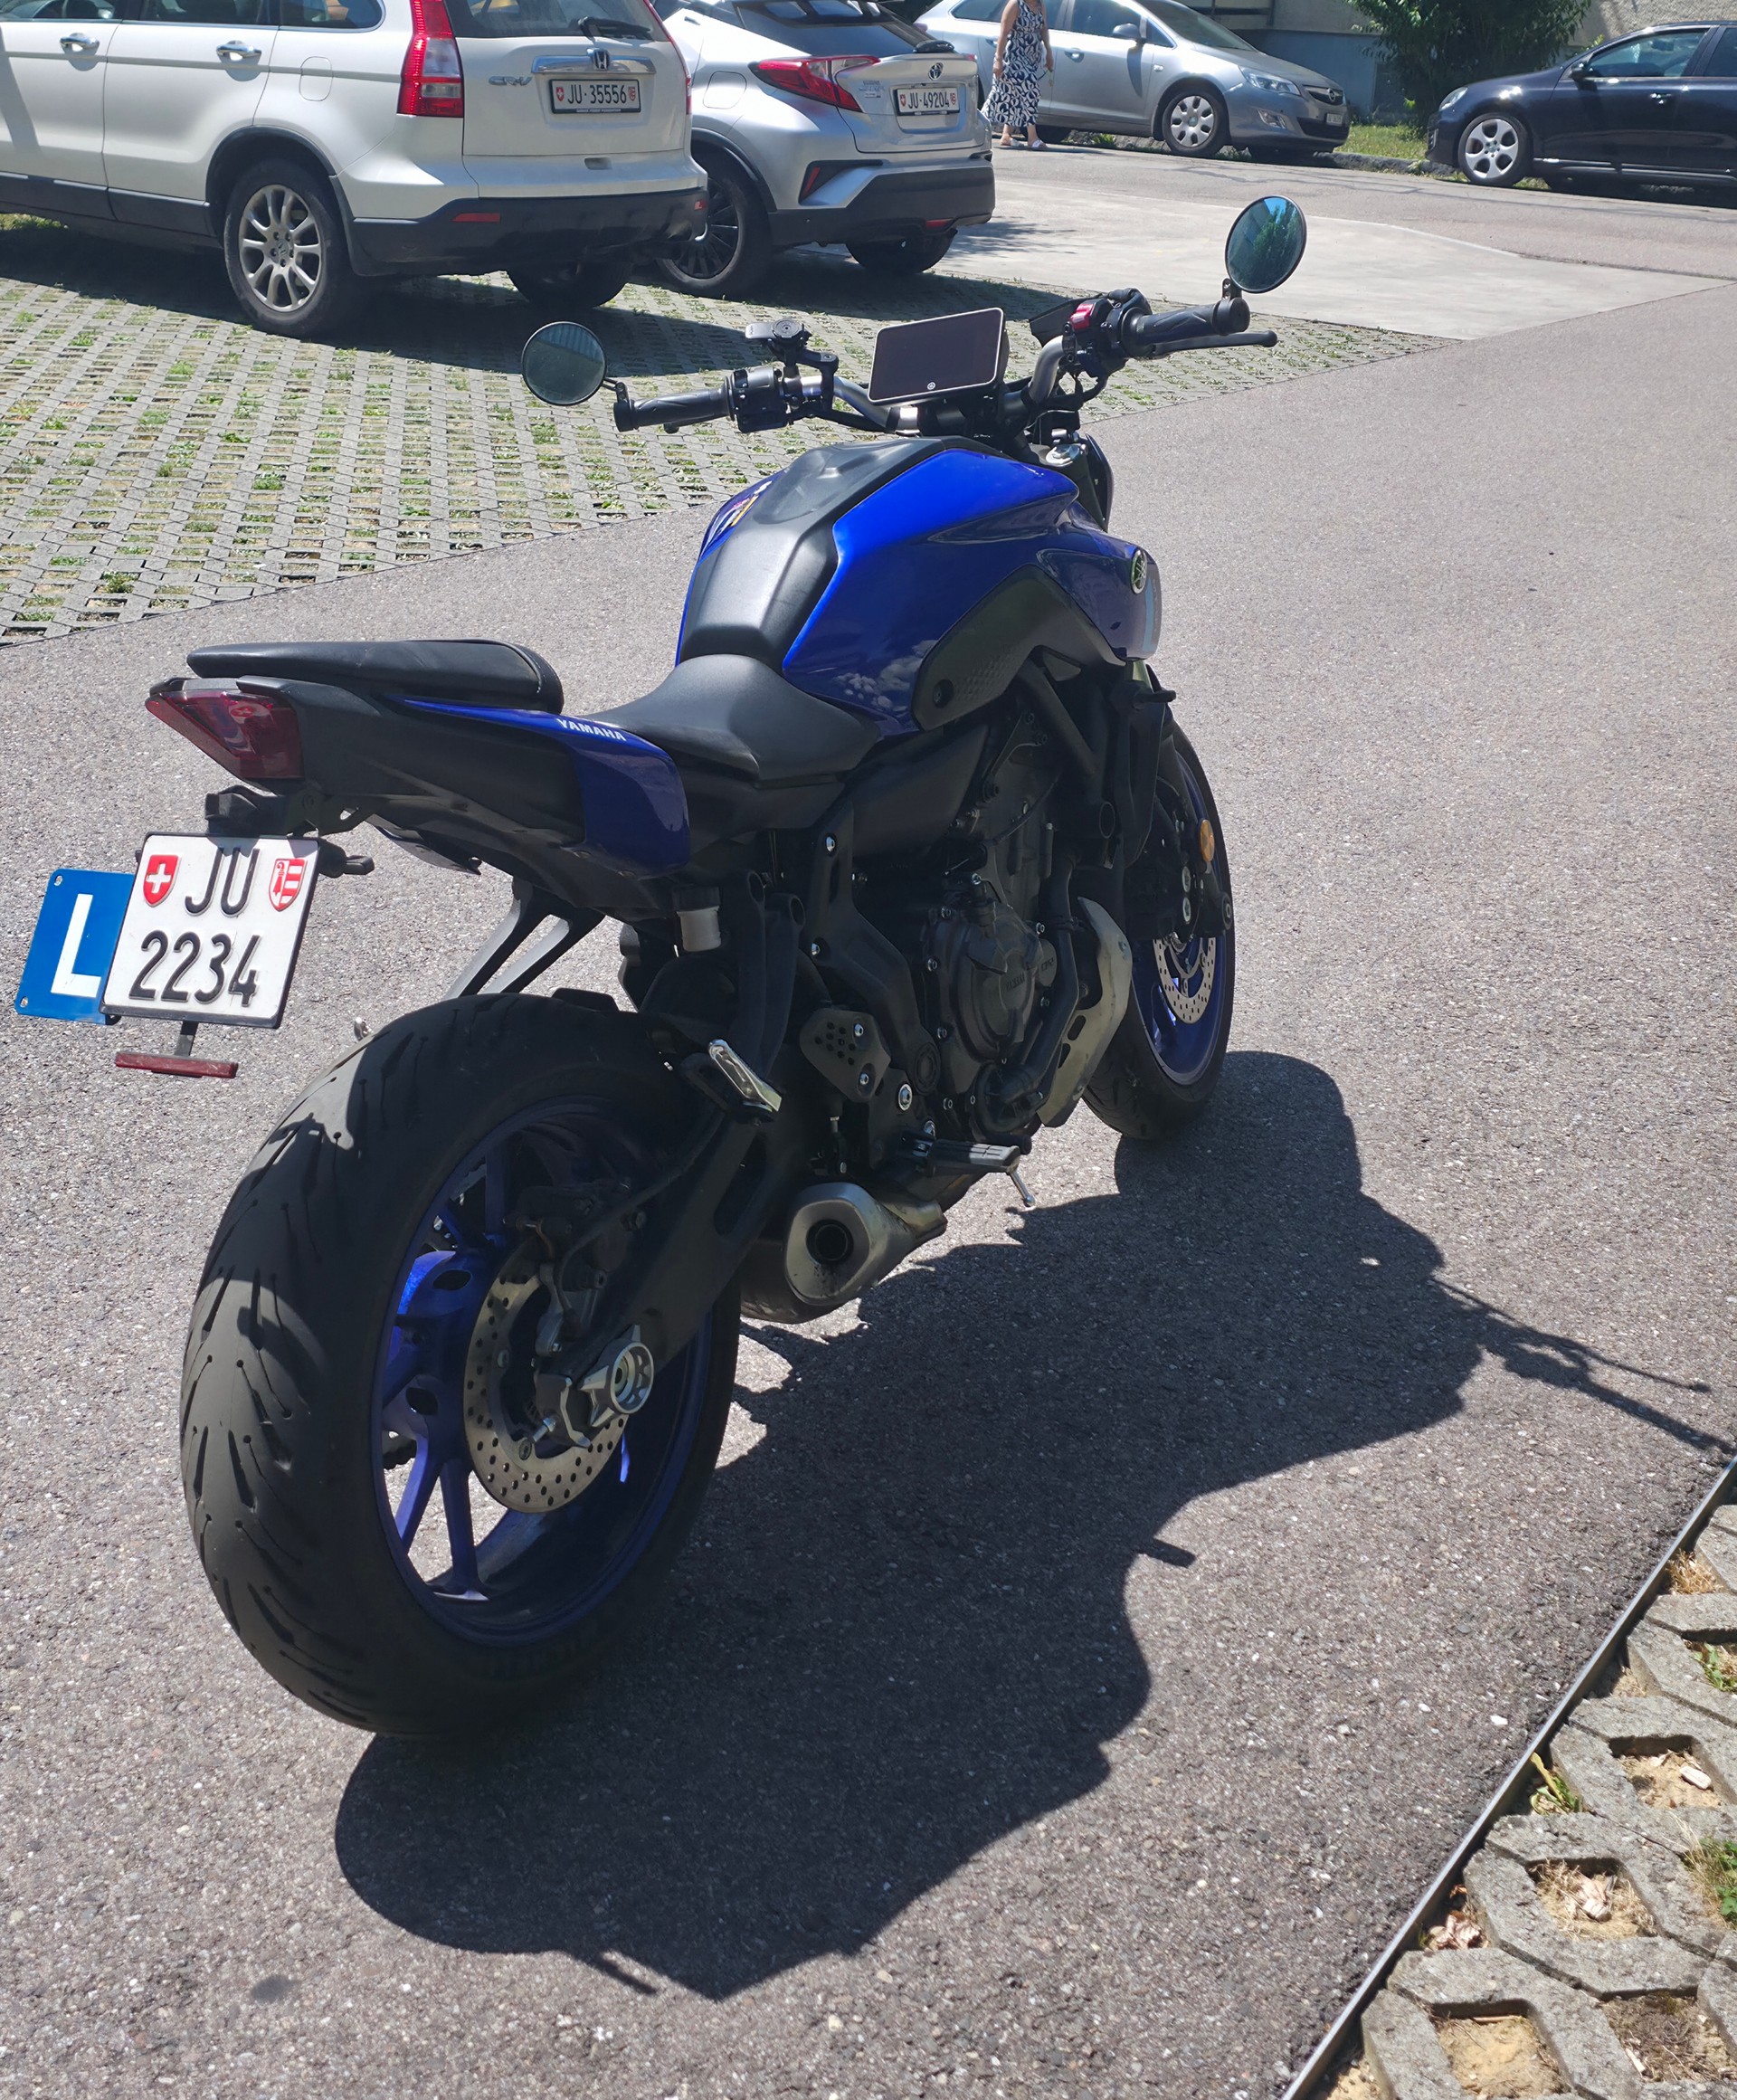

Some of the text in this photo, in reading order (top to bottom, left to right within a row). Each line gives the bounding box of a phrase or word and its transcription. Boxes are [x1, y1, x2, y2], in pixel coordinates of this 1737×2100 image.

[556, 718, 626, 741] YAMAHA
[185, 847, 261, 917] JU
[51, 893, 101, 997] L
[128, 930, 262, 1007] 2234
